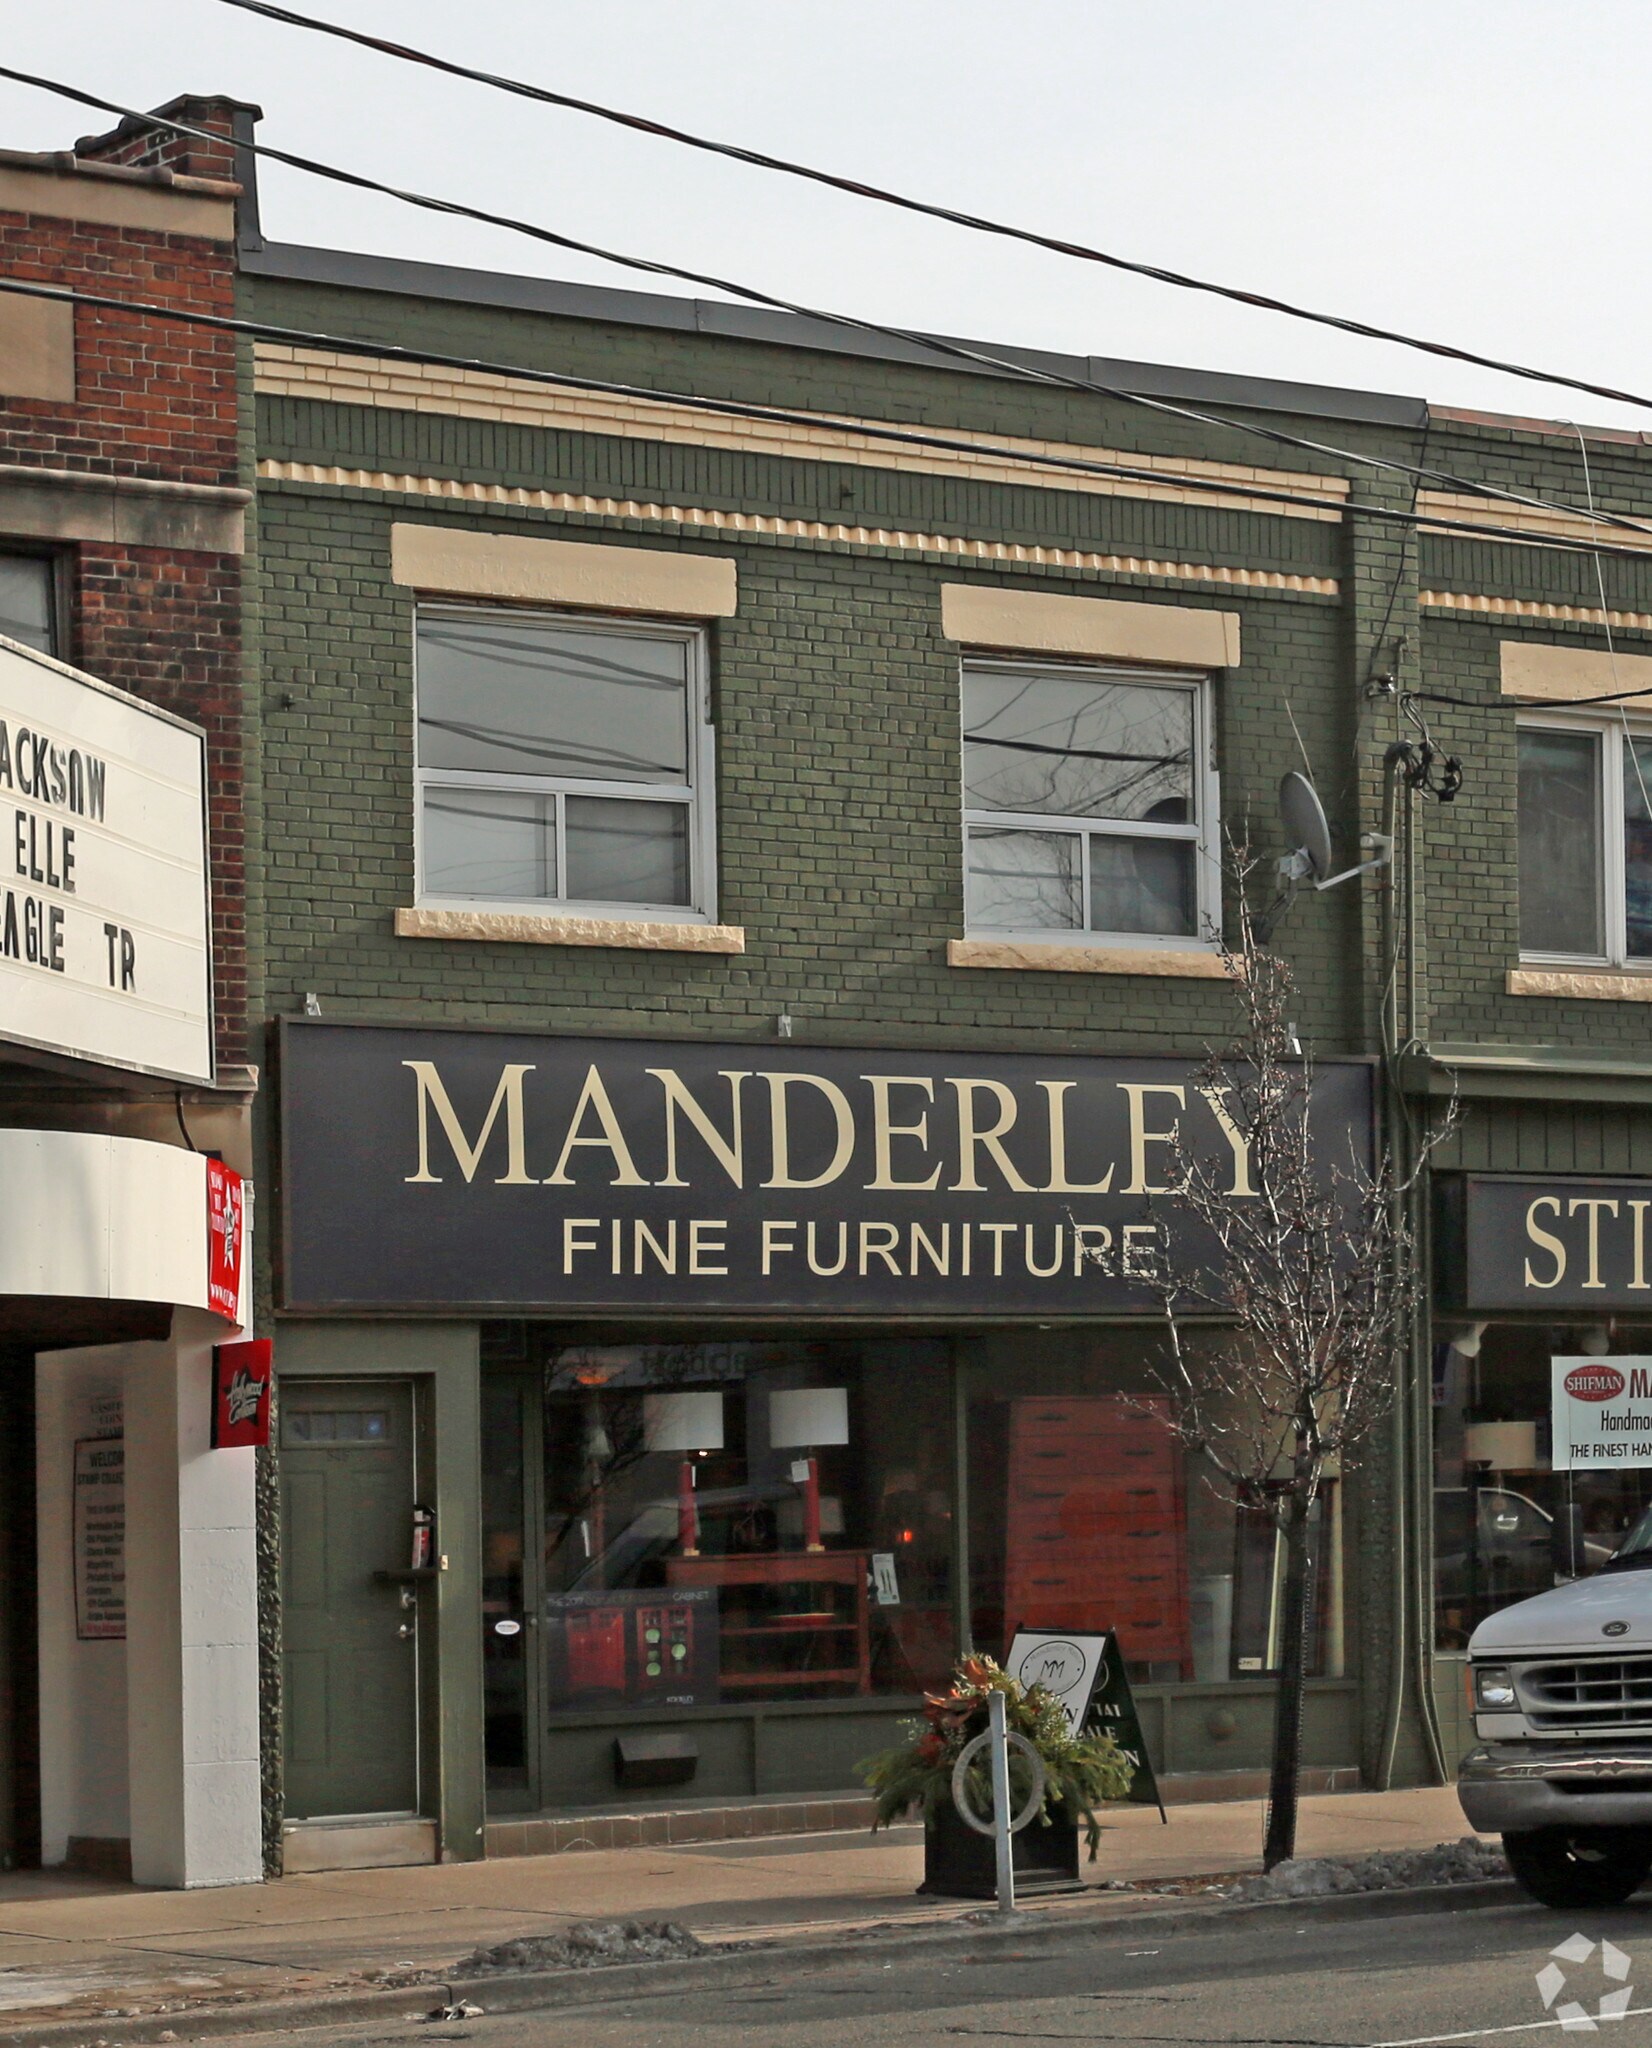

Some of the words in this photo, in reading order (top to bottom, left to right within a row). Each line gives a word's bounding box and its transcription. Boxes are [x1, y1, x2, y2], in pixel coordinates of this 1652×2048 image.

[15, 809, 76, 893] ELLE
[103, 922, 136, 993] TR
[402, 1060, 1282, 1198] MANDERLEY
[562, 1217, 729, 1276] FINE
[760, 1220, 1158, 1278] FURNITURE
[1566, 1377, 1623, 1391] SHIFMAN
[1629, 1369, 1652, 1398] M
[1601, 1408, 1652, 1431] Handma
[1570, 1443, 1590, 1458] THE
[1593, 1443, 1628, 1457] FINEST
